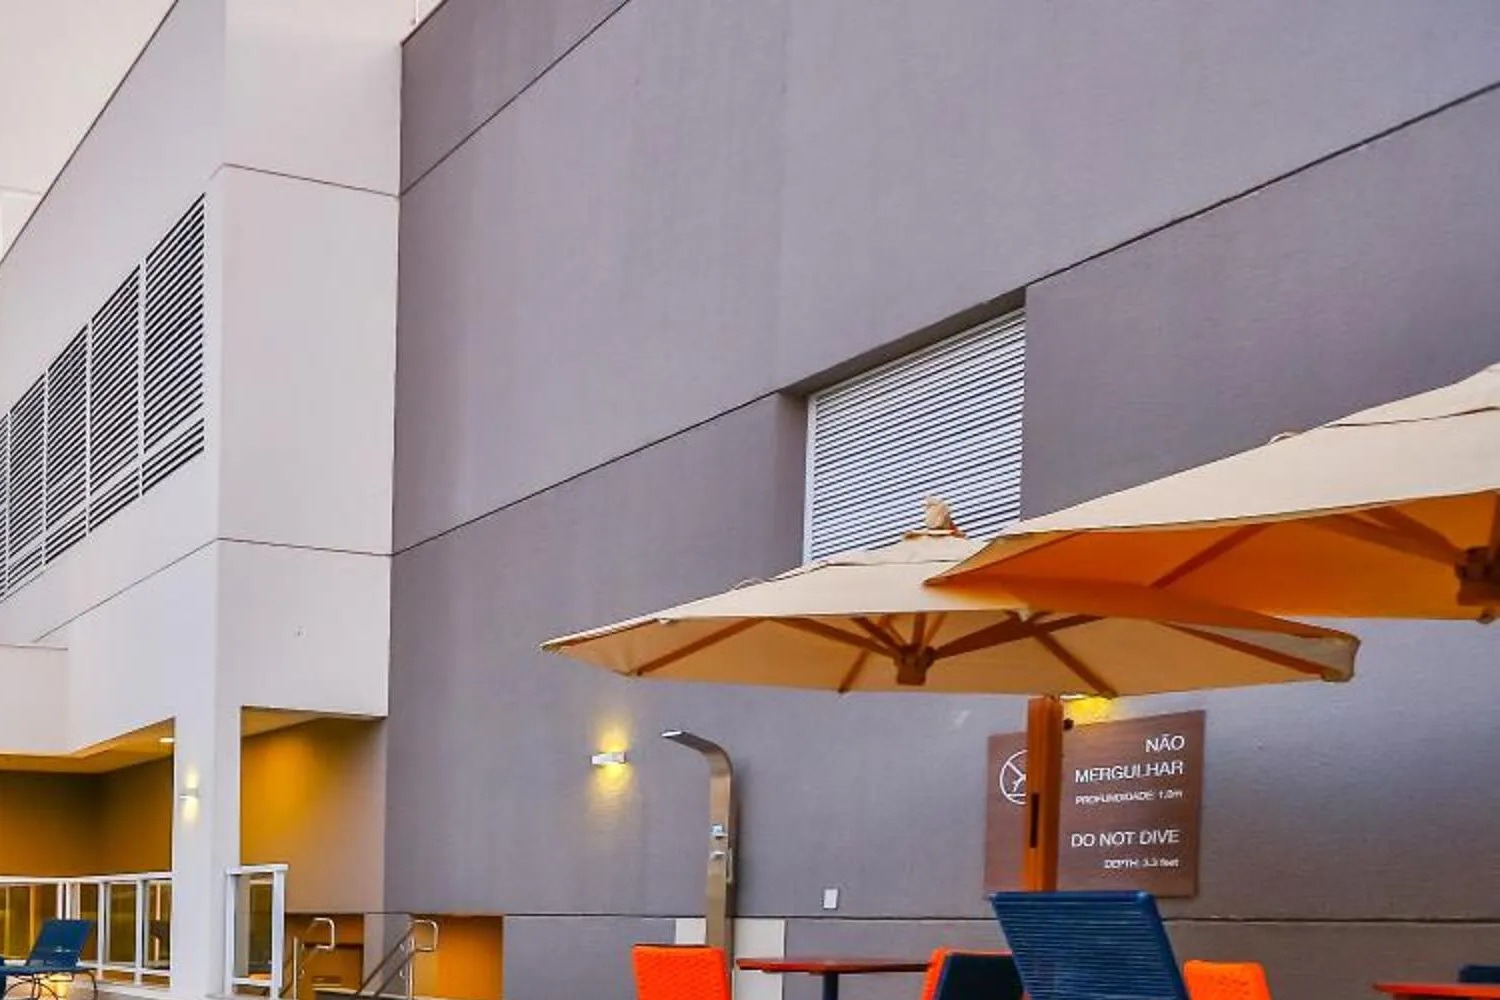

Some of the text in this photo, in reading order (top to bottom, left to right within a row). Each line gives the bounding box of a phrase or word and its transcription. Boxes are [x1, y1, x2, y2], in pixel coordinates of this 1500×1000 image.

[1145, 733, 1185, 753] NÃO
[1075, 761, 1184, 783] MERGULHAR
[1071, 829, 1181, 848] DO NOT DIVE
